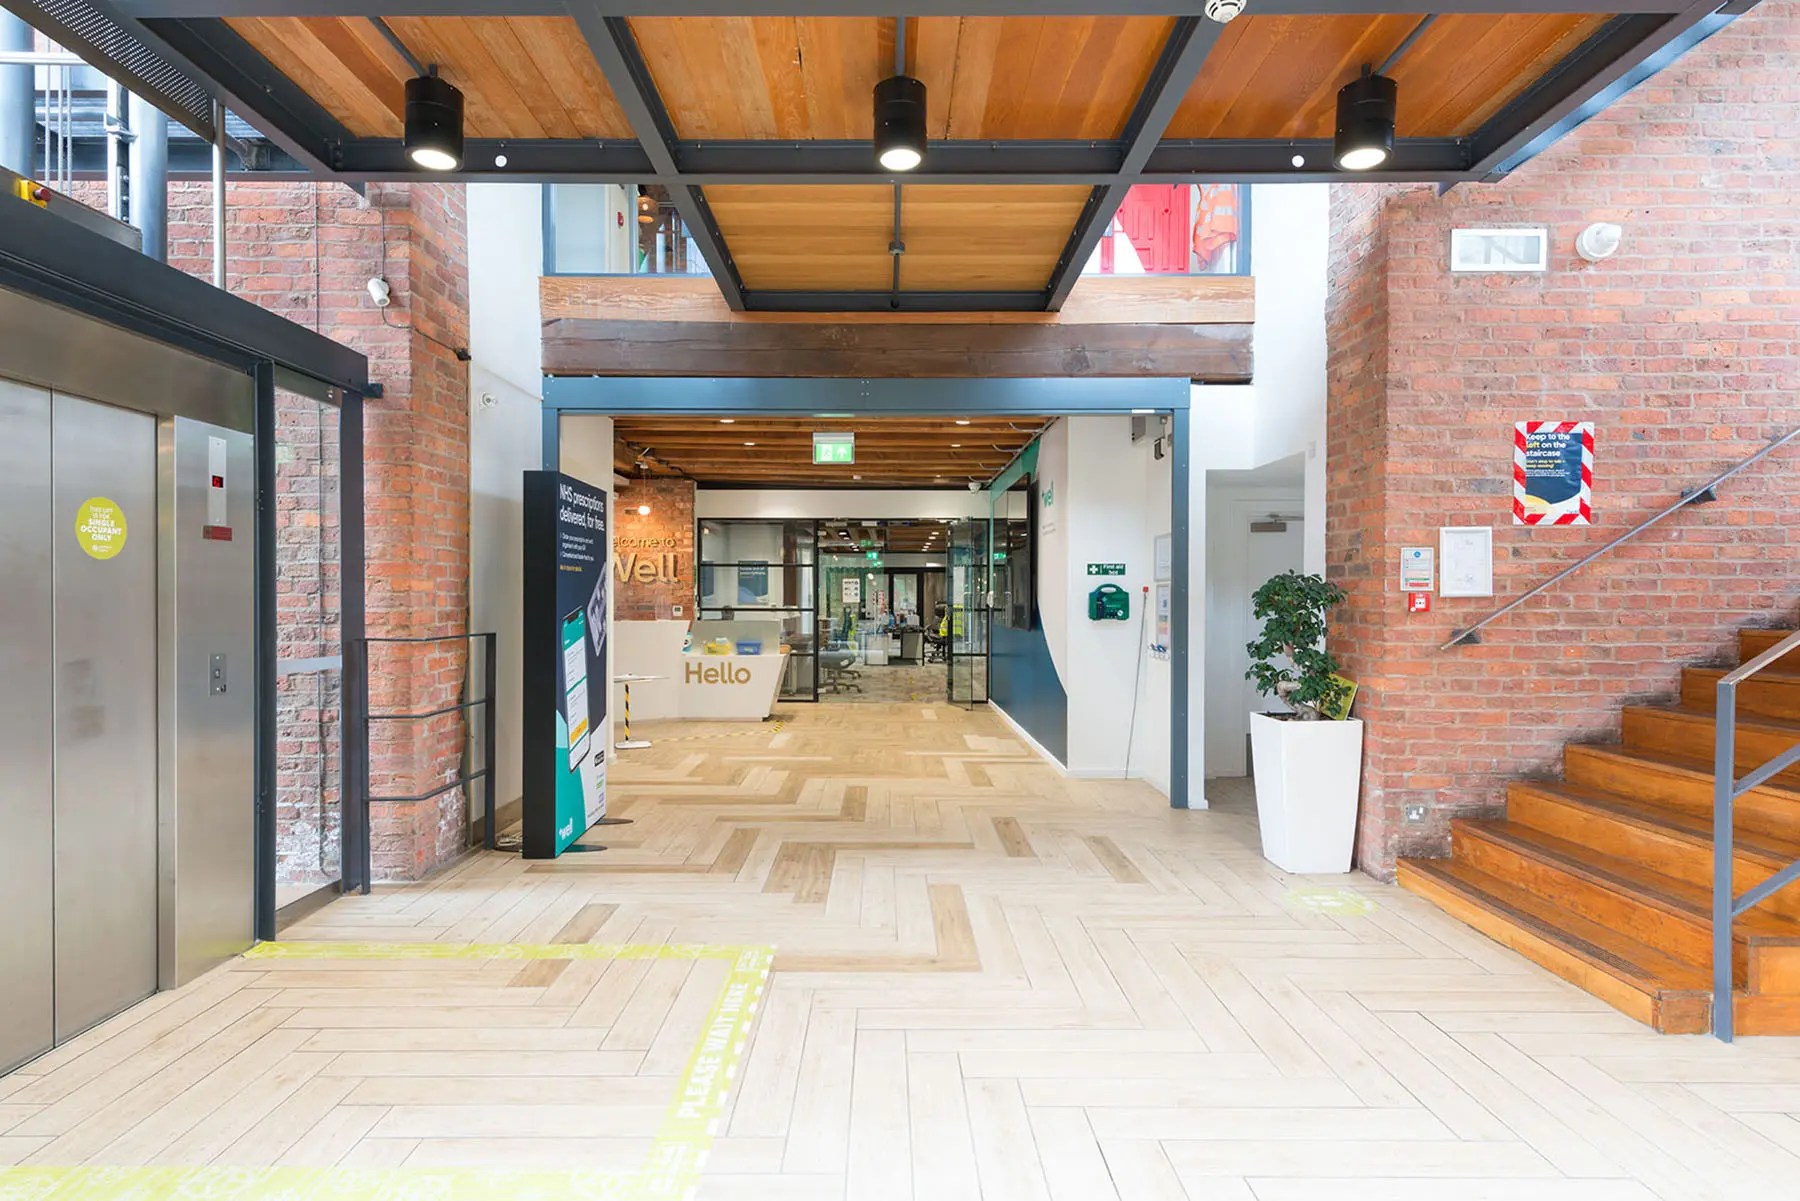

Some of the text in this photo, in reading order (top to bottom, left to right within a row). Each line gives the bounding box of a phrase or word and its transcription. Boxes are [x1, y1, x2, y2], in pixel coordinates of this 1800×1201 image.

[1547, 433, 1557, 441] to
[1558, 433, 1571, 441] the
[1553, 441, 1567, 449] the
[560, 483, 605, 513] NHS prescriptions
[88, 518, 115, 527] SINGLE
[80, 524, 122, 535] OCCUPANT
[91, 533, 112, 542] ONLY
[613, 536, 677, 549] elcome to
[685, 661, 751, 684] Hello
[718, 982, 749, 1013] HERE
[701, 1013, 742, 1051] WAIT
[676, 1055, 722, 1119] PLEASE
